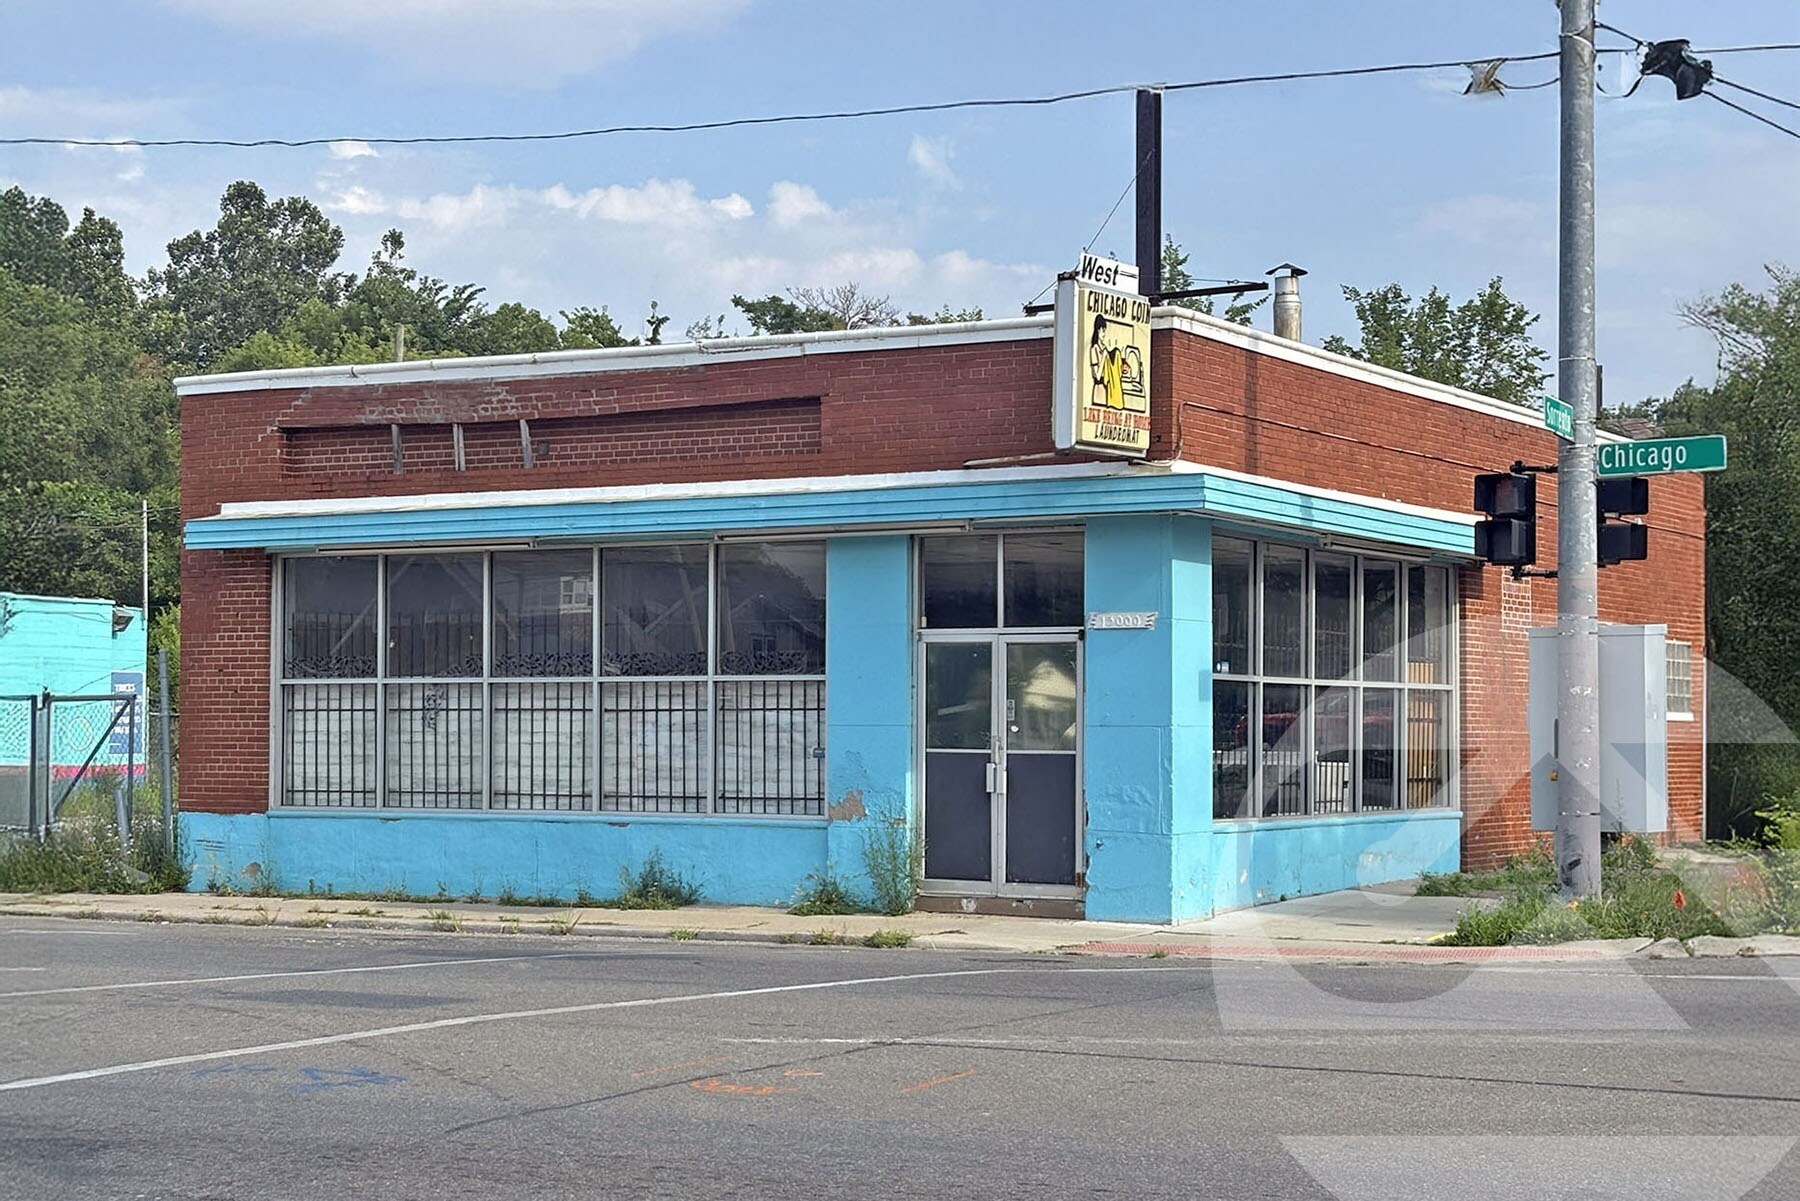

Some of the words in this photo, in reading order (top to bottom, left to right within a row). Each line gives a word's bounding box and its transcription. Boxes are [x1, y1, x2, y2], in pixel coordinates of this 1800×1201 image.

[1081, 255, 1119, 286] West
[1087, 290, 1127, 318] CHICAGO
[1131, 300, 1150, 324] COIN
[1094, 423, 1140, 444] LAUNDROMAT
[1601, 445, 1687, 470] Chicago
